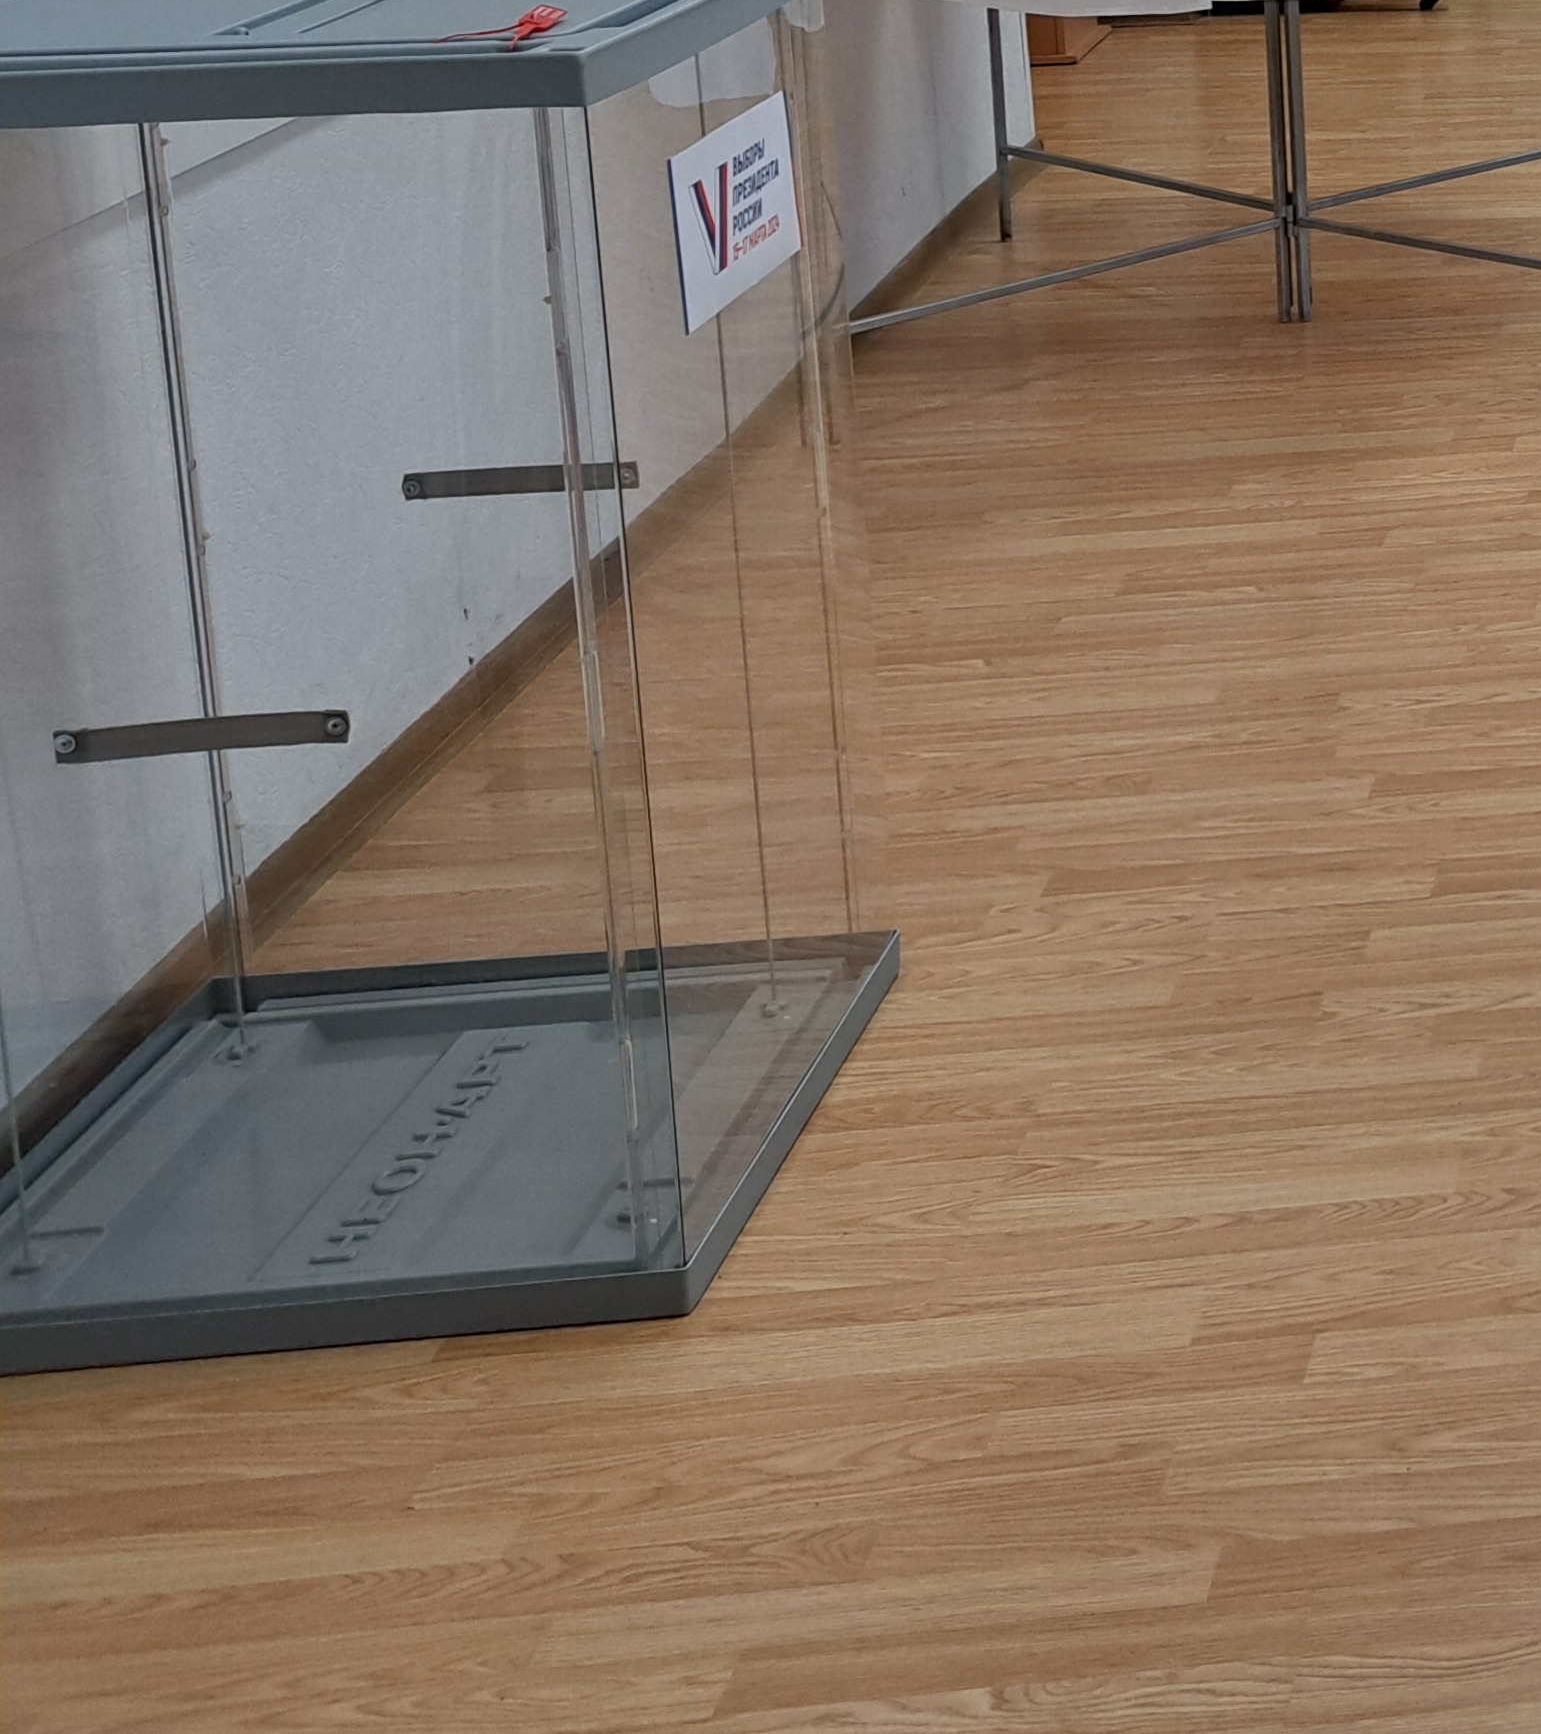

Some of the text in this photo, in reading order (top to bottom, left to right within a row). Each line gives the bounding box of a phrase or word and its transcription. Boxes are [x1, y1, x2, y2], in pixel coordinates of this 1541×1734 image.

[732, 137, 765, 177] ВЫБОРЫ
[732, 157, 779, 207] ПРЕЗИДЕНТА
[732, 197, 762, 236] РОССИИ
